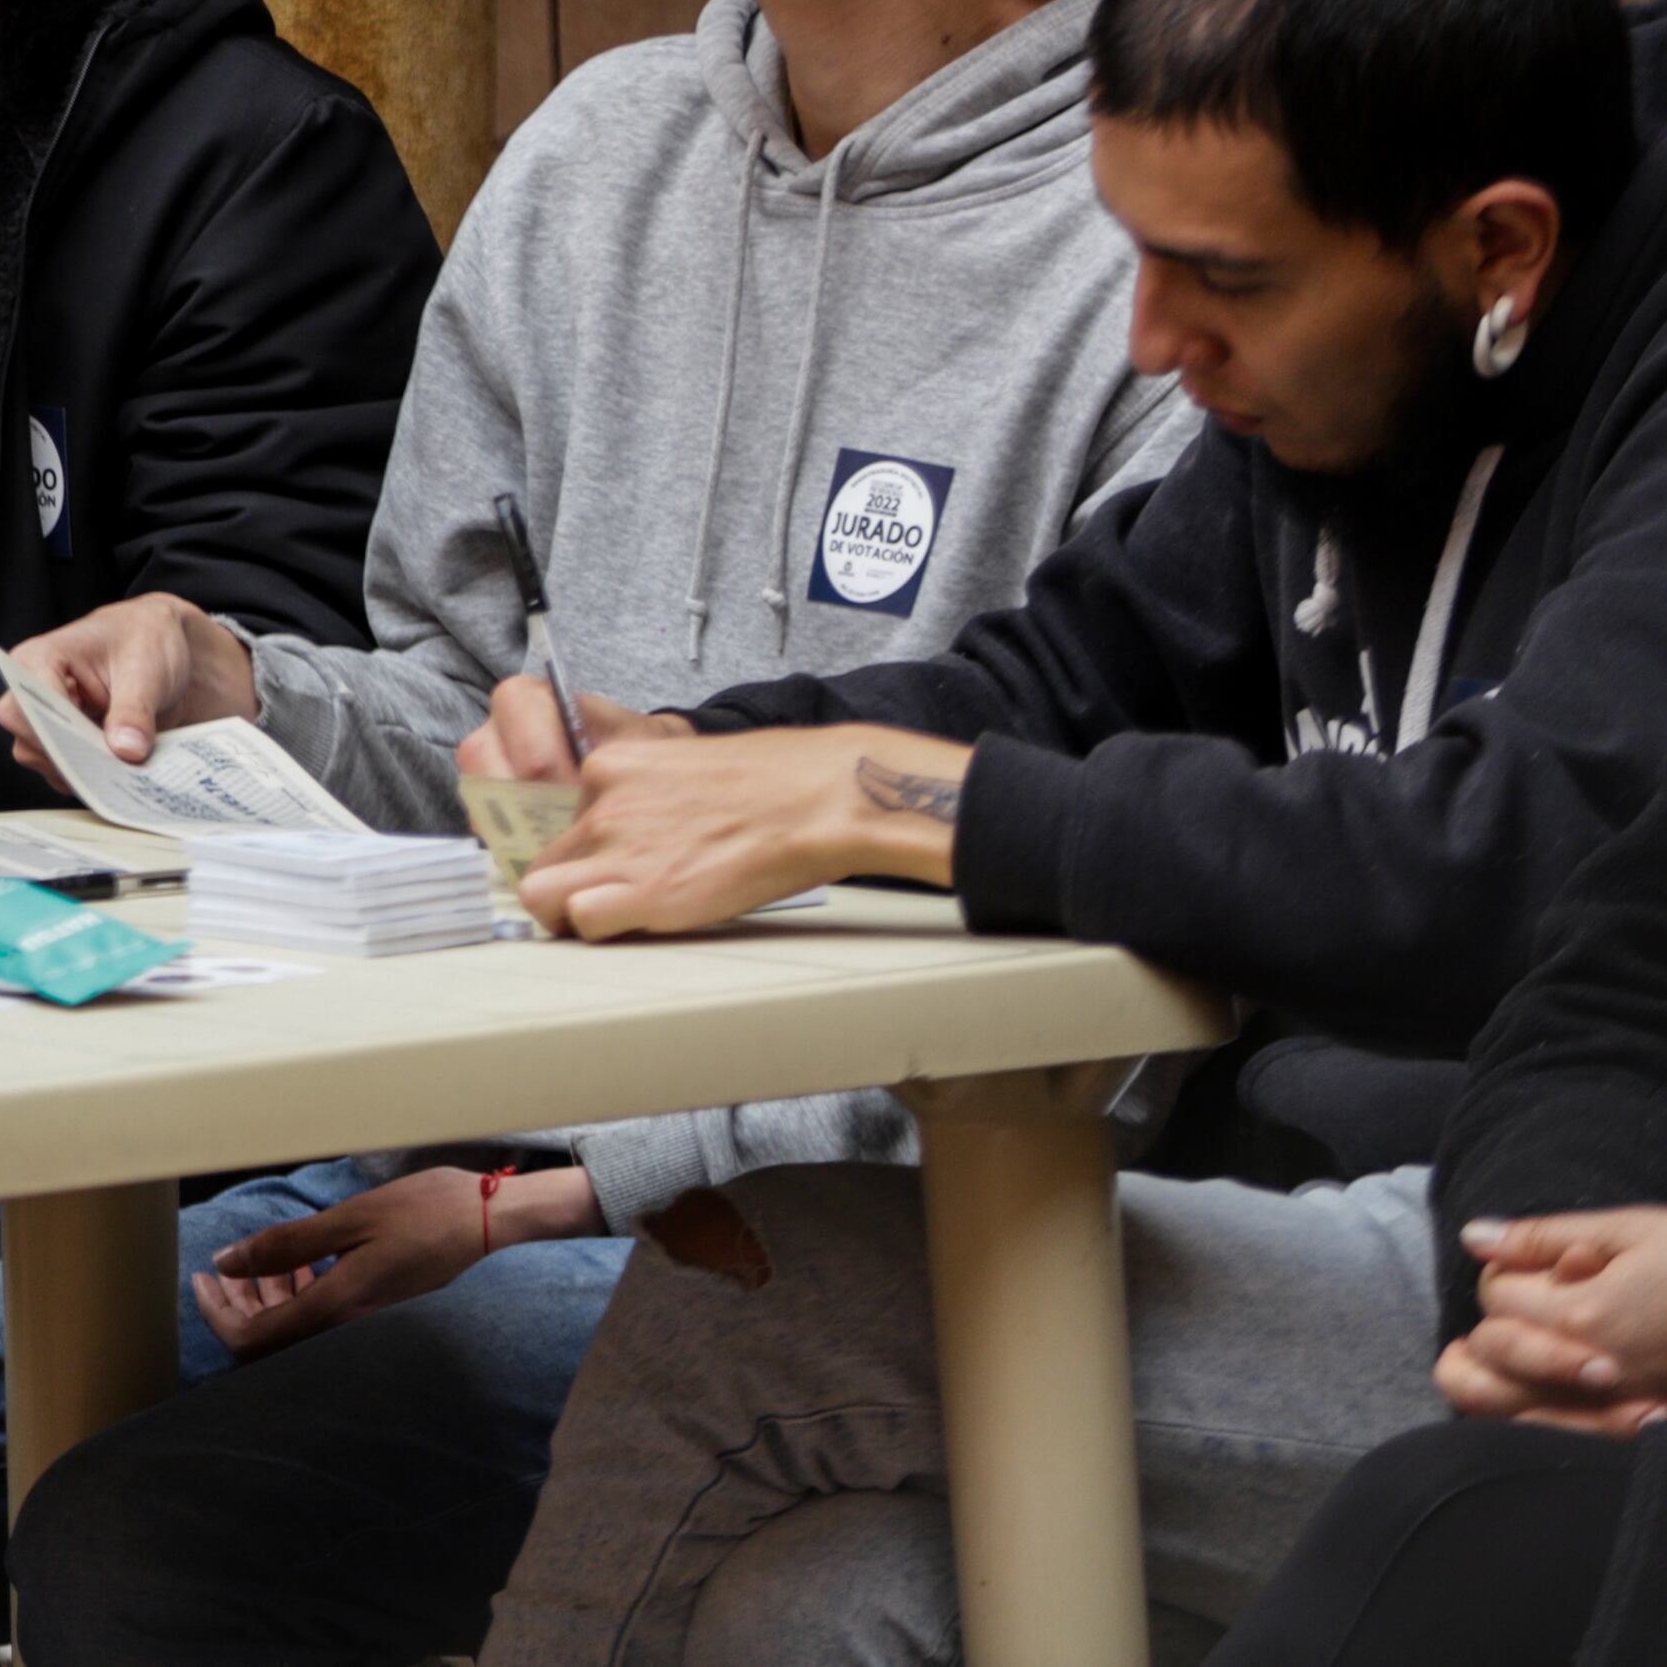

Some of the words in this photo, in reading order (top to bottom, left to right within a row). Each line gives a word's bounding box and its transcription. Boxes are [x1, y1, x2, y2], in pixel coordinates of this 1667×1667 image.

[866, 493, 901, 511] 2022
[831, 512, 923, 548] JURADO
[830, 540, 844, 553] DE
[847, 542, 915, 565] VOTACIÓN
